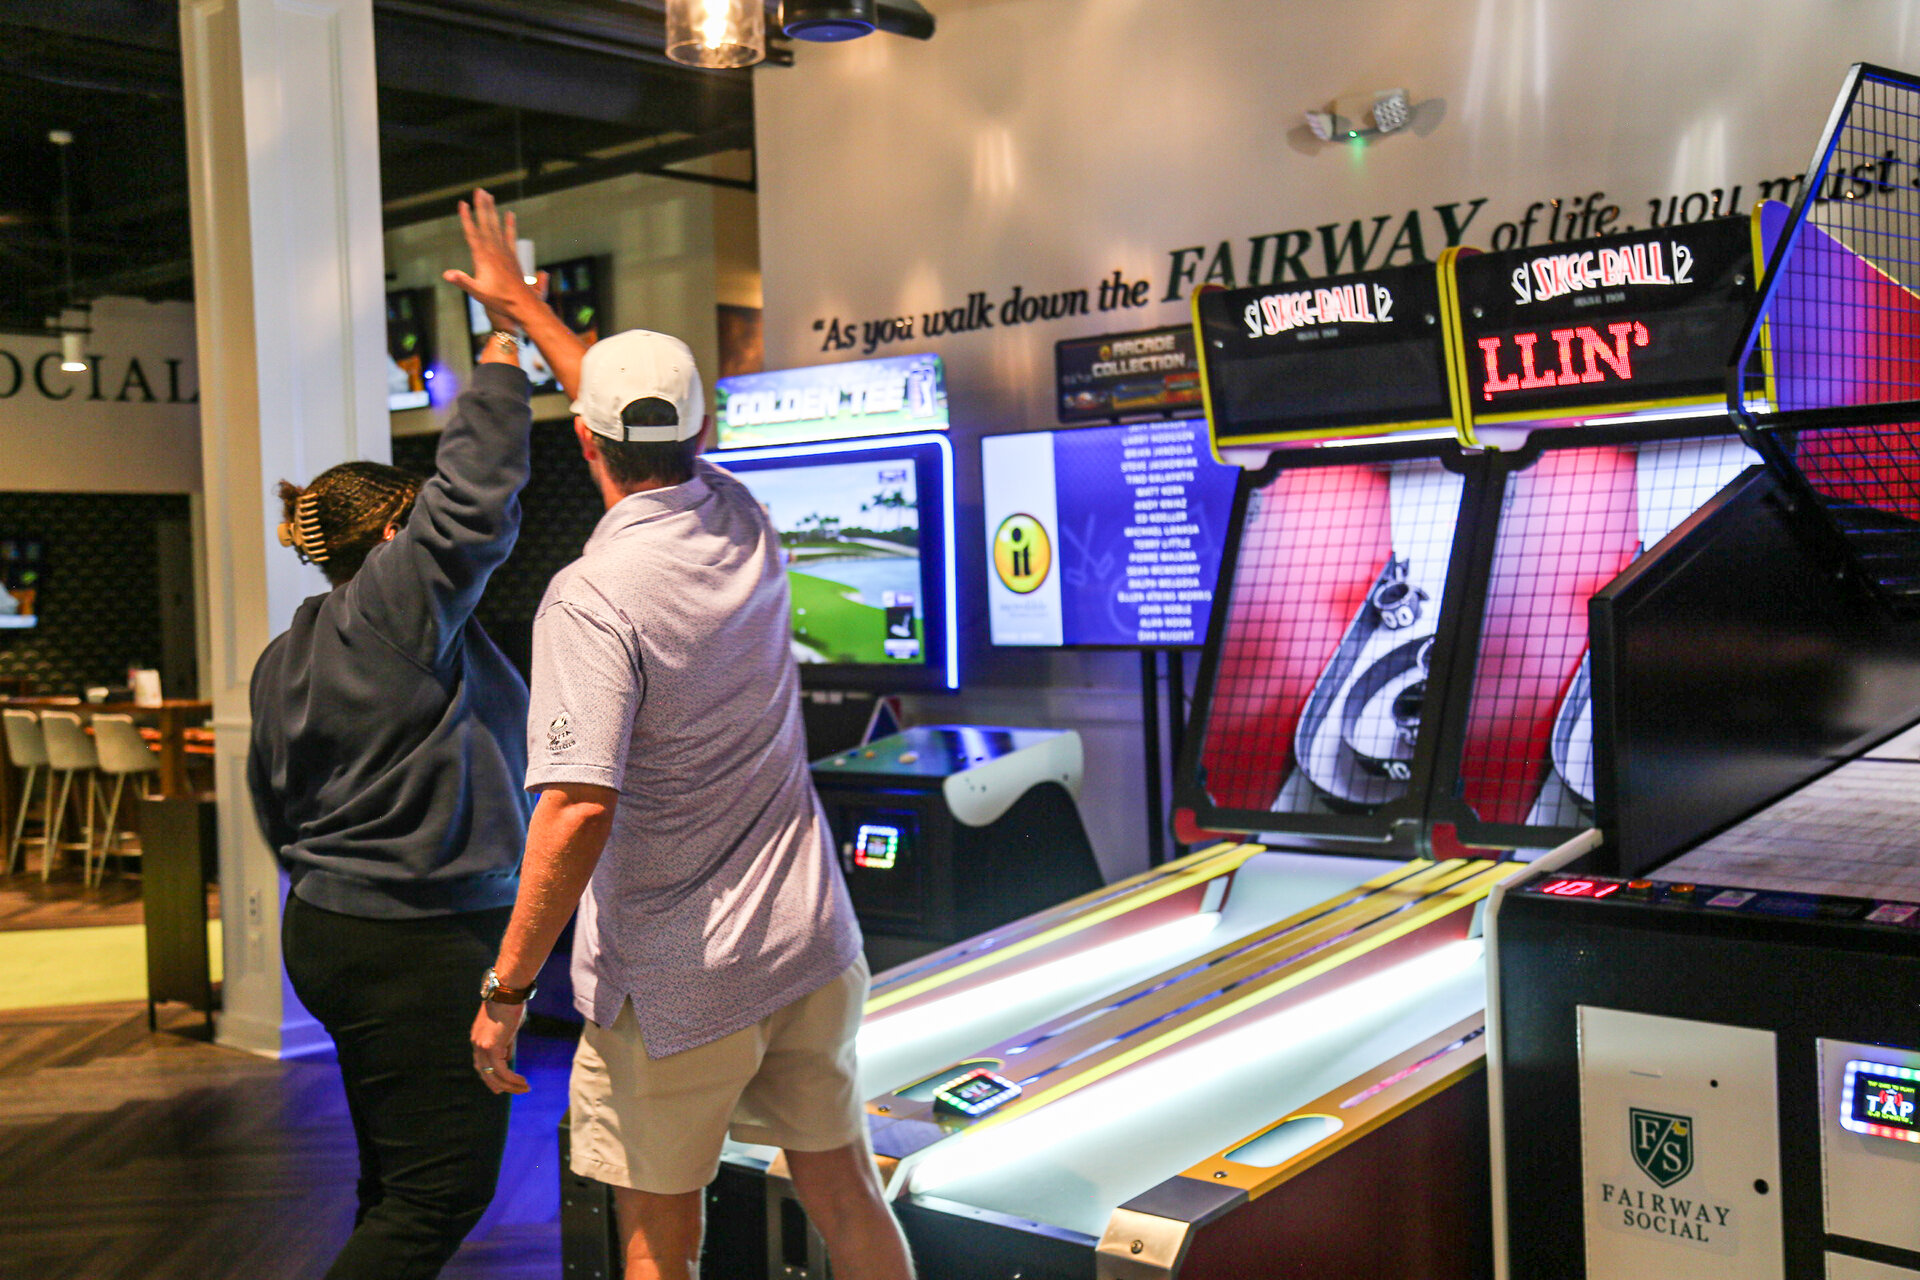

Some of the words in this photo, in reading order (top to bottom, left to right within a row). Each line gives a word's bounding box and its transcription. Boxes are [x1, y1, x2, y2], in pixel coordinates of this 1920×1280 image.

[863, 319, 914, 354] you
[922, 292, 995, 338] walk
[1000, 286, 1089, 325] down
[1098, 271, 1149, 313] the
[1161, 198, 1488, 303] FAIRWAY
[1491, 199, 1544, 252] of
[1649, 186, 1742, 228] you
[1092, 352, 1186, 378] COLLECTION
[1112, 334, 1175, 358] ARCADE
[726, 386, 842, 428] GOLDEN
[849, 371, 907, 416] TEE
[1012, 528, 1031, 576] it
[1866, 1094, 1915, 1119] TAP
[1602, 1183, 1731, 1226] FAIRWAY
[1623, 1208, 1710, 1243] SOCIAL
